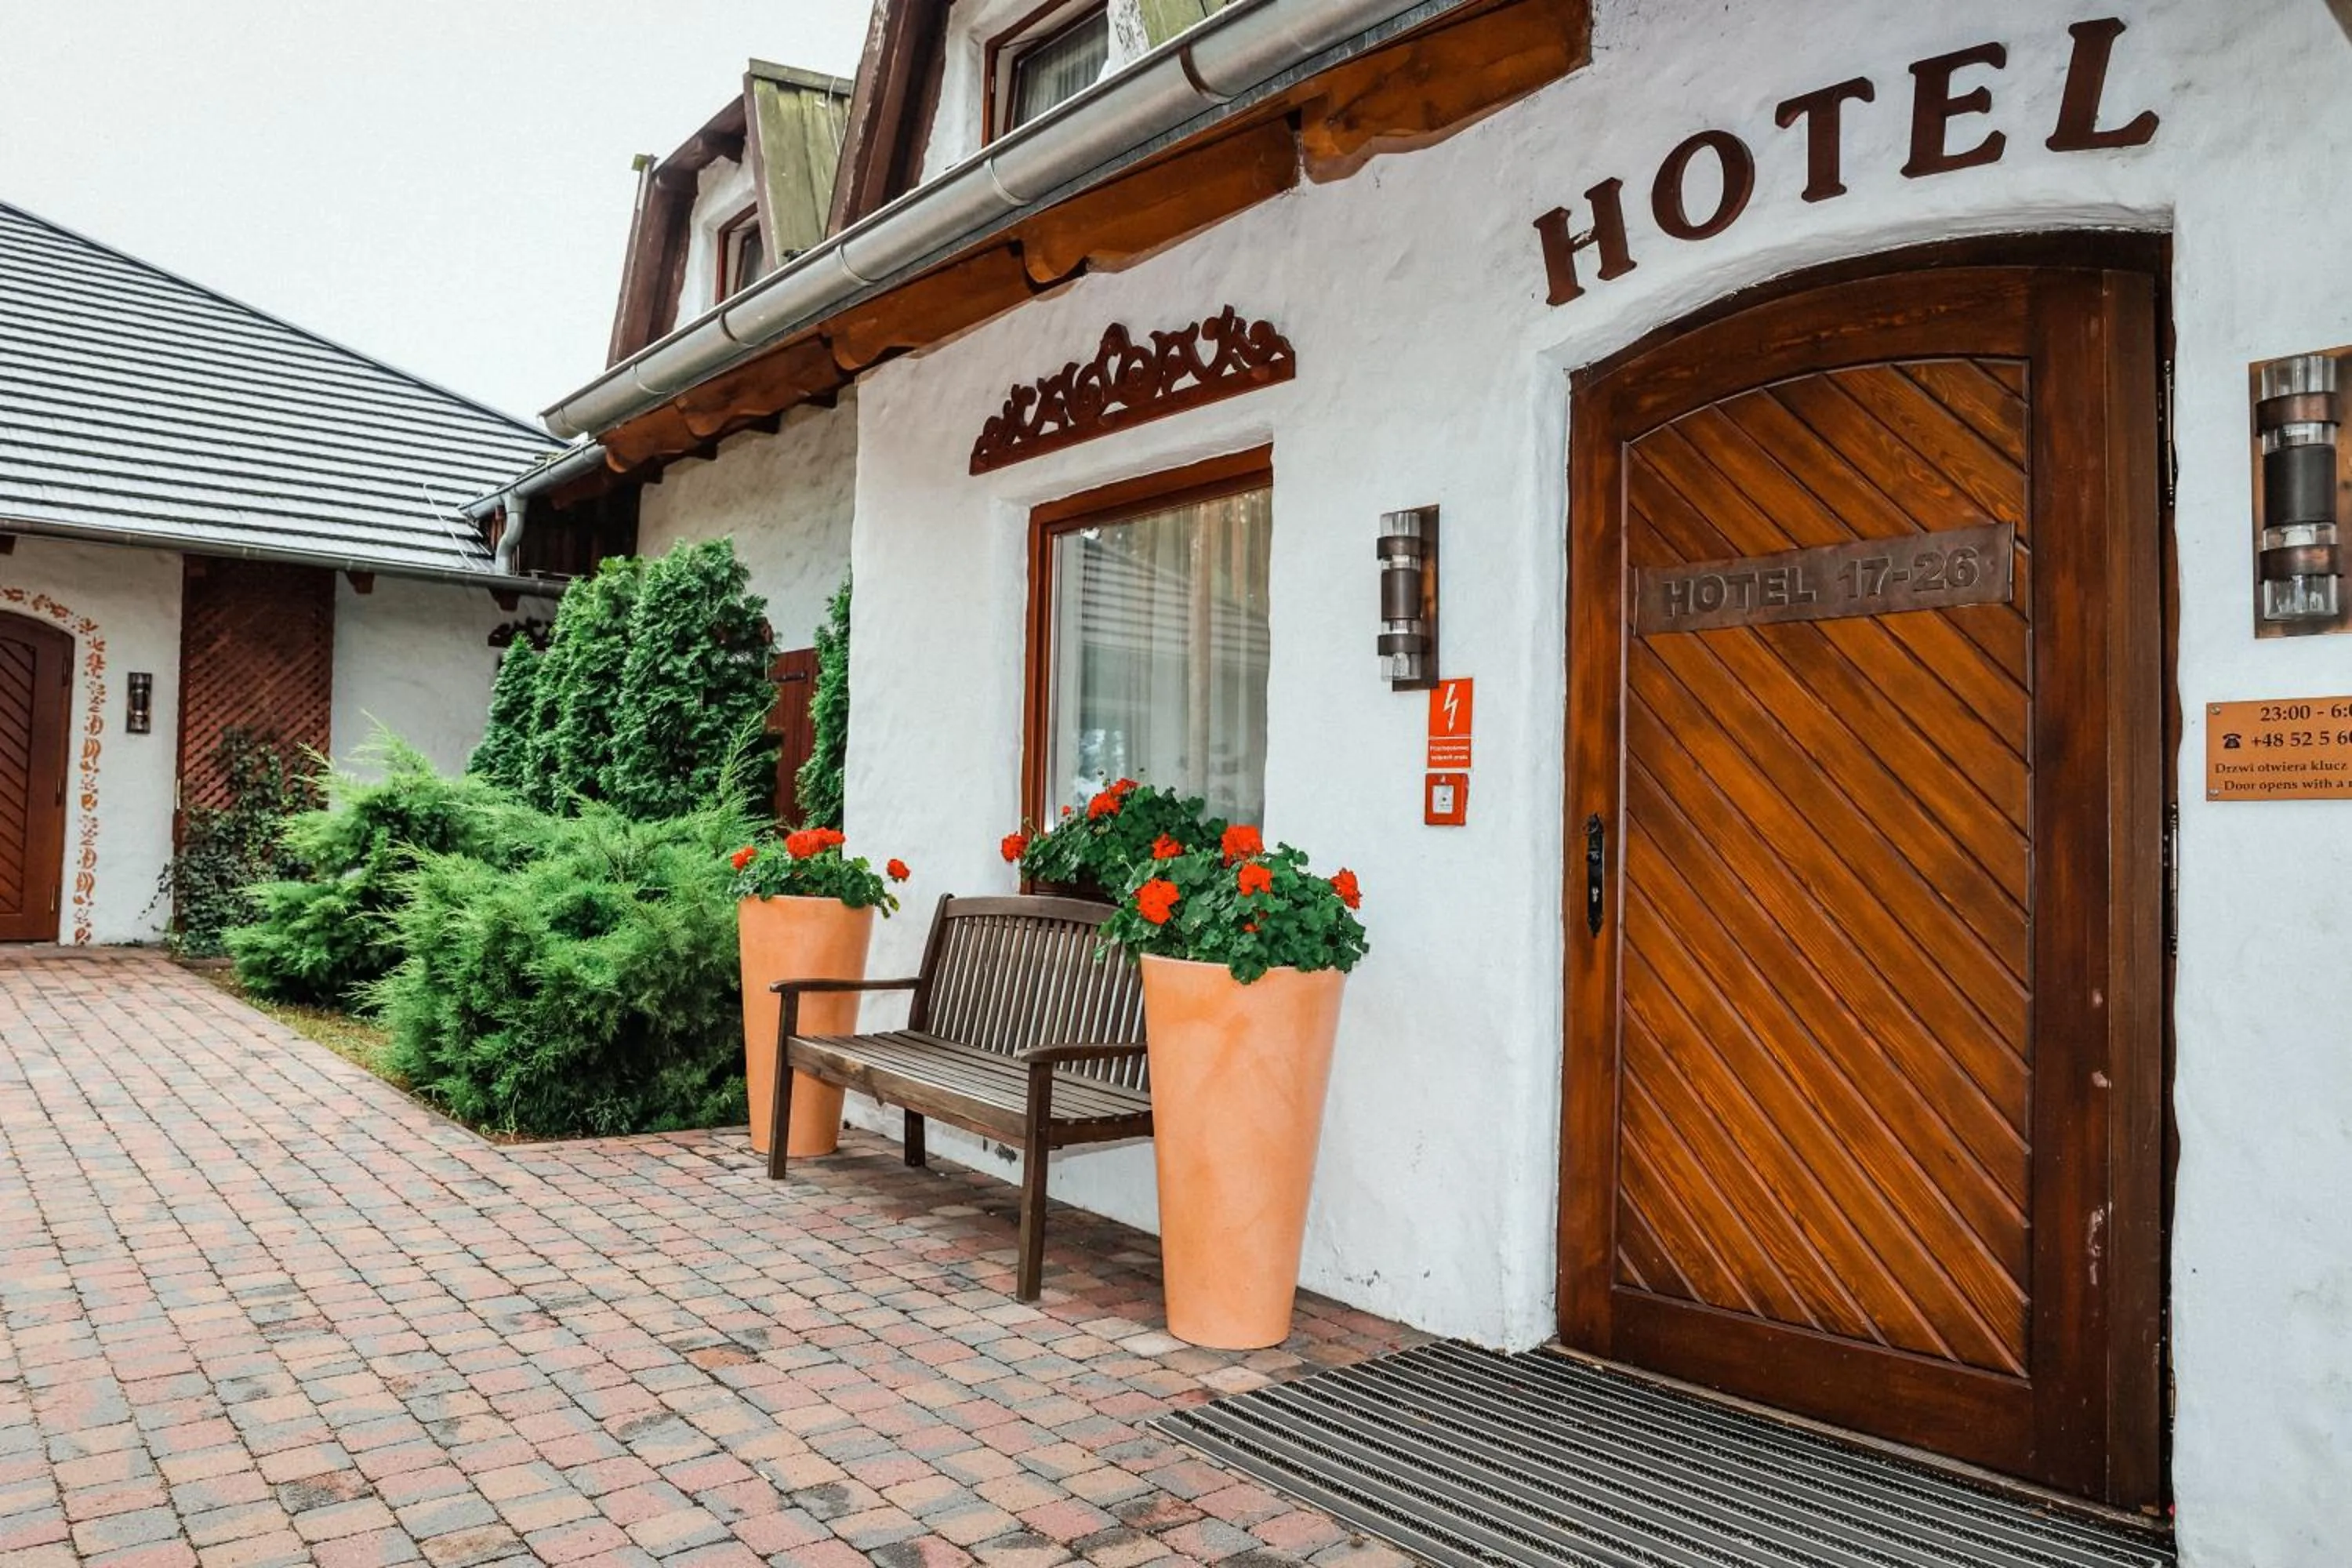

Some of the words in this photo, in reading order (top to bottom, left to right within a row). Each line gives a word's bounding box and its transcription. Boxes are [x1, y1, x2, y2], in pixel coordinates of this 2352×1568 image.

[1534, 16, 2160, 306] HOTEL
[1661, 565, 1817, 618] HOTEL
[1837, 547, 1980, 600] 17-26
[2260, 705, 2310, 721] 23:00
[2252, 732, 2284, 747] +48
[2290, 731, 2313, 747] 52
[2318, 731, 2330, 746] 5
[2215, 763, 2255, 774] Drzwi
[2257, 761, 2307, 772] otwiera
[2310, 760, 2347, 771] klucz
[2223, 780, 2254, 791] Door
[2259, 781, 2298, 793] opens
[2302, 778, 2332, 789] with
